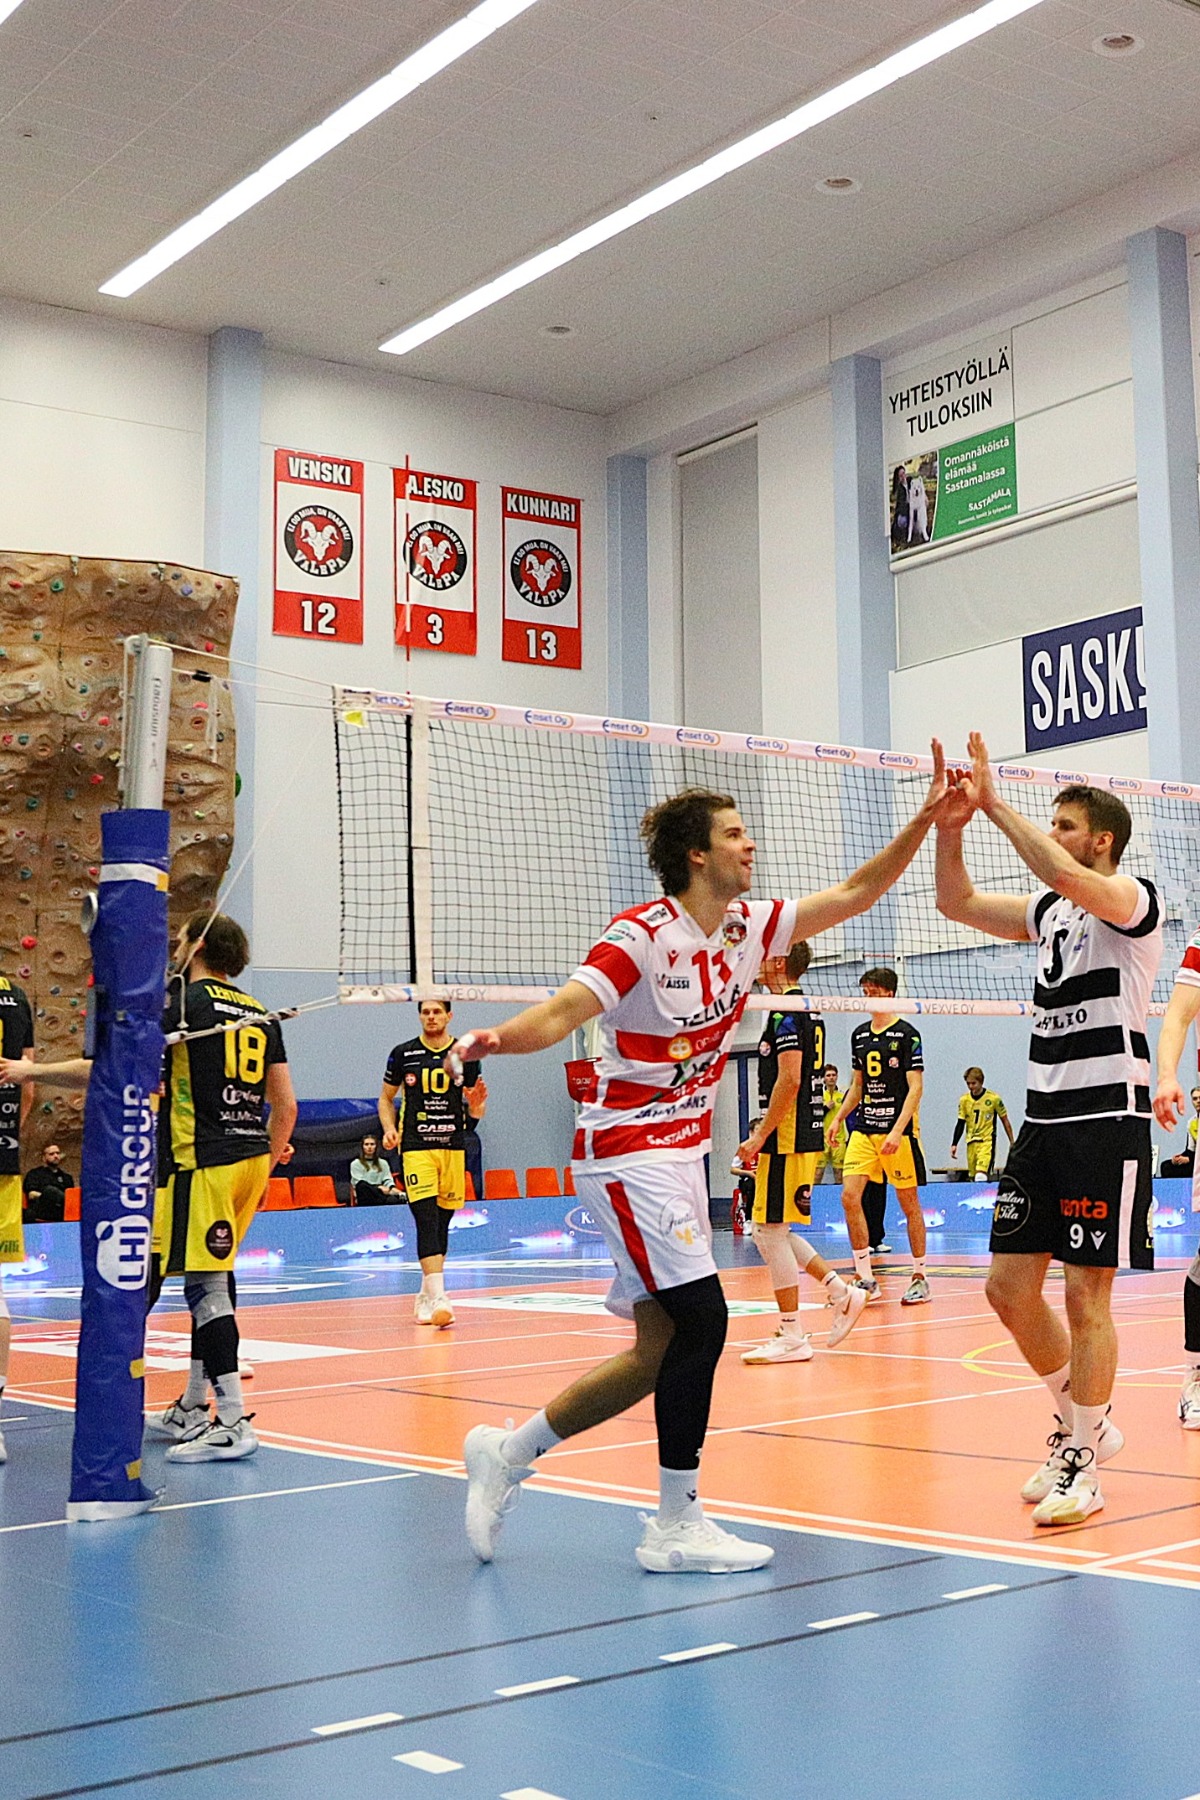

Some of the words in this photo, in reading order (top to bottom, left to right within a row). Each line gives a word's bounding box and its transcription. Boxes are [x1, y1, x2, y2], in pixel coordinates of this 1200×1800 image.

[889, 345, 1010, 415] YHTEISTYÖLLÄ
[907, 388, 993, 437] TULOKSIIN
[944, 435, 1010, 468] Omannäköistä
[288, 456, 352, 486] VENSKI
[944, 463, 978, 481] elämää
[945, 466, 1006, 494] Sastamalassa
[408, 474, 464, 501] A.ESKO
[968, 487, 1012, 512] SASTAMALA
[507, 492, 576, 522] KUNNARI
[293, 549, 347, 575] VALEPA
[519, 581, 566, 605] VALEPA
[301, 600, 336, 635] 12
[426, 613, 444, 645] 3
[526, 628, 558, 661] 13
[224, 1019, 268, 1084] 18
[866, 1051, 882, 1077] 6
[422, 1068, 450, 1094] 10
[1, 1103, 19, 1114] OY
[120, 1083, 151, 1210] GROUP
[406, 1173, 419, 1187] 10
[1070, 1224, 1084, 1249] 9
[117, 1225, 150, 1283] LHI
